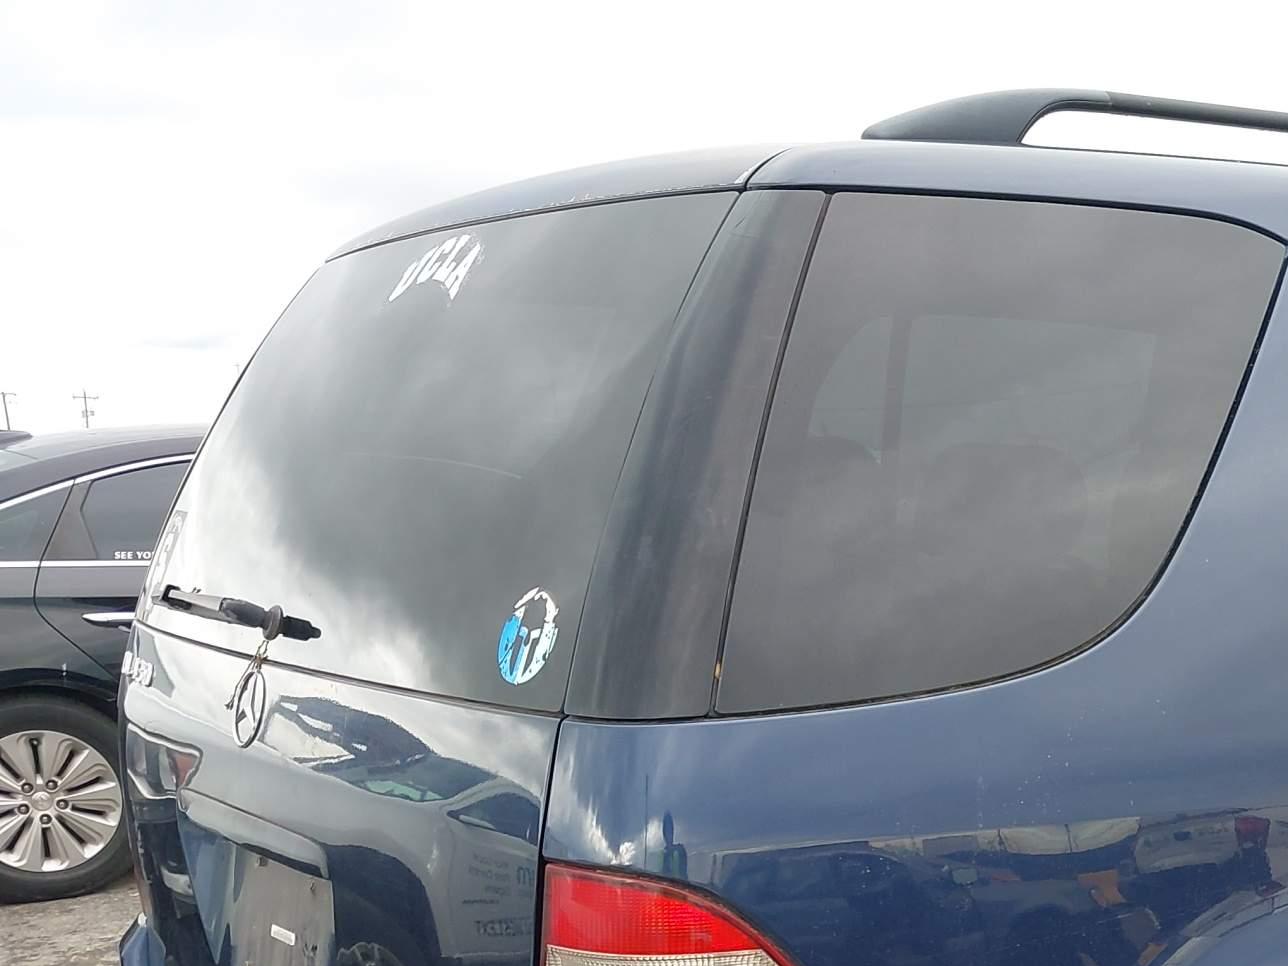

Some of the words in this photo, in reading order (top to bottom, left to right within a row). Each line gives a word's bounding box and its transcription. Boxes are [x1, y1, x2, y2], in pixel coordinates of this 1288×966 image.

[389, 234, 481, 302] UCLA
[114, 551, 134, 560] SEE
[136, 551, 154, 560] YO
